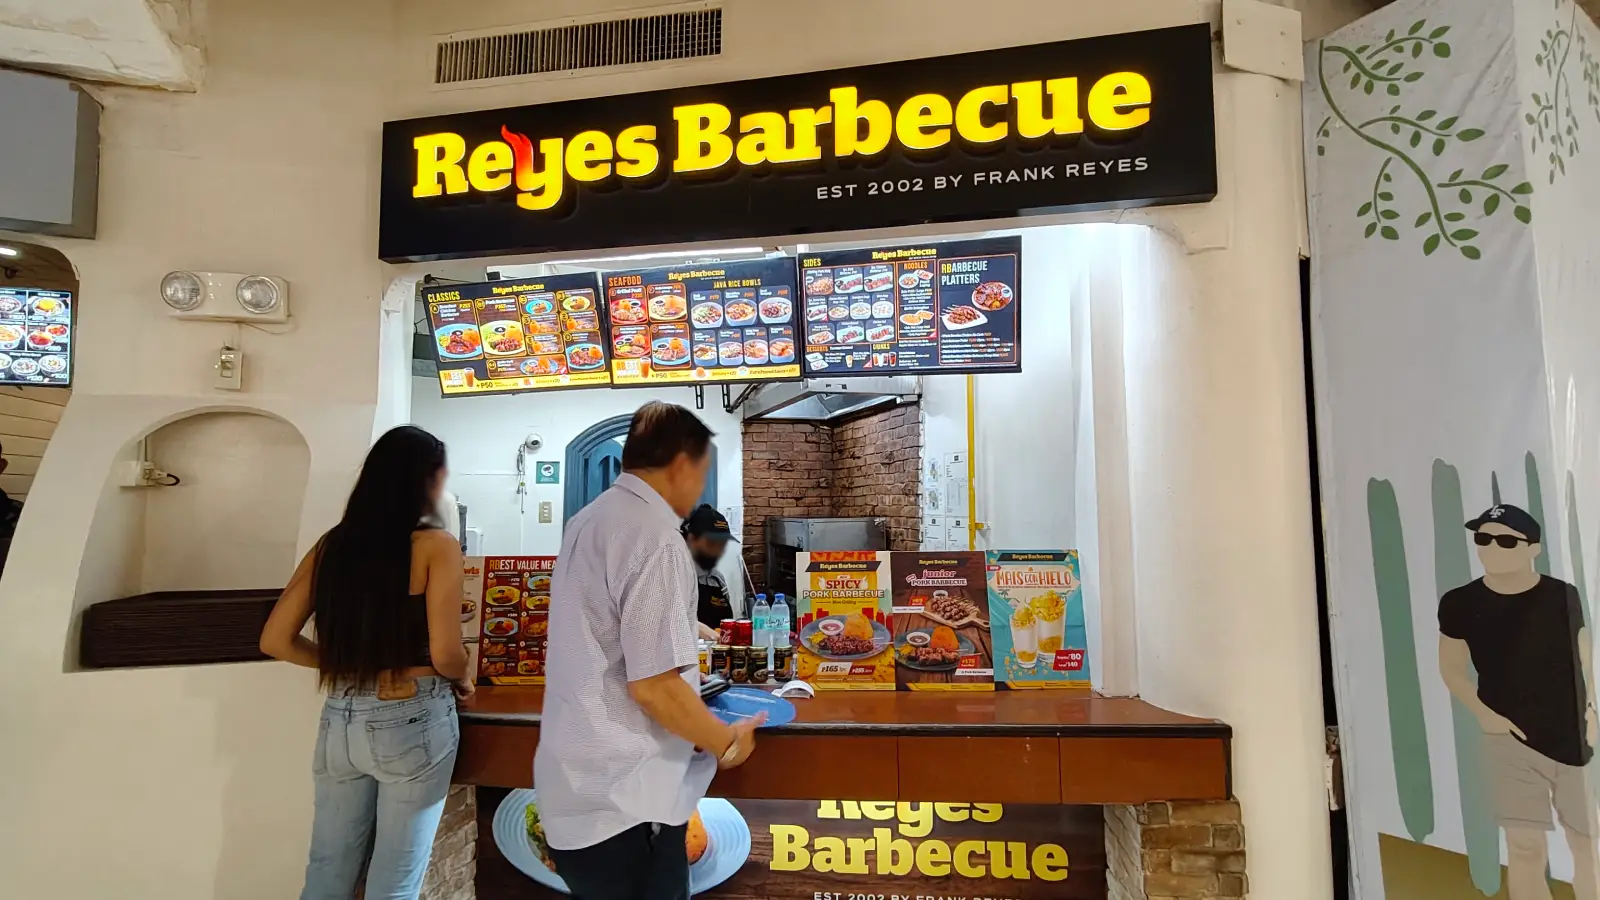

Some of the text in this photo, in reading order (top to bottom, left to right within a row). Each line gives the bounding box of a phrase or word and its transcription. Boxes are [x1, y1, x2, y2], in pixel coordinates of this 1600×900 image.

[412, 70, 1152, 211] Reyes Barbecue
[816, 156, 1150, 201] EST 2002 BY FRANK REYES
[872, 249, 936, 260] Reyes Barbecue
[803, 258, 822, 267] SIDES
[941, 261, 988, 274] RBARBECUE
[608, 276, 642, 286] SEAFOOD
[668, 270, 725, 281] Reyes Barbecue
[941, 274, 980, 286] PLATTERS
[512, 284, 544, 292] Barbecue
[714, 278, 762, 288] JAVA RICE BOWLS
[428, 291, 460, 302] CLASSICS
[490, 560, 515, 570] RBEST
[517, 560, 540, 570] VALUE
[923, 569, 956, 579] junior
[996, 572, 1024, 585] MAIS
[1039, 571, 1071, 585] HIELO
[826, 580, 861, 589] SPICY
[803, 590, 884, 598] PORK BARBECUE
[769, 824, 1069, 882] Barbecue
